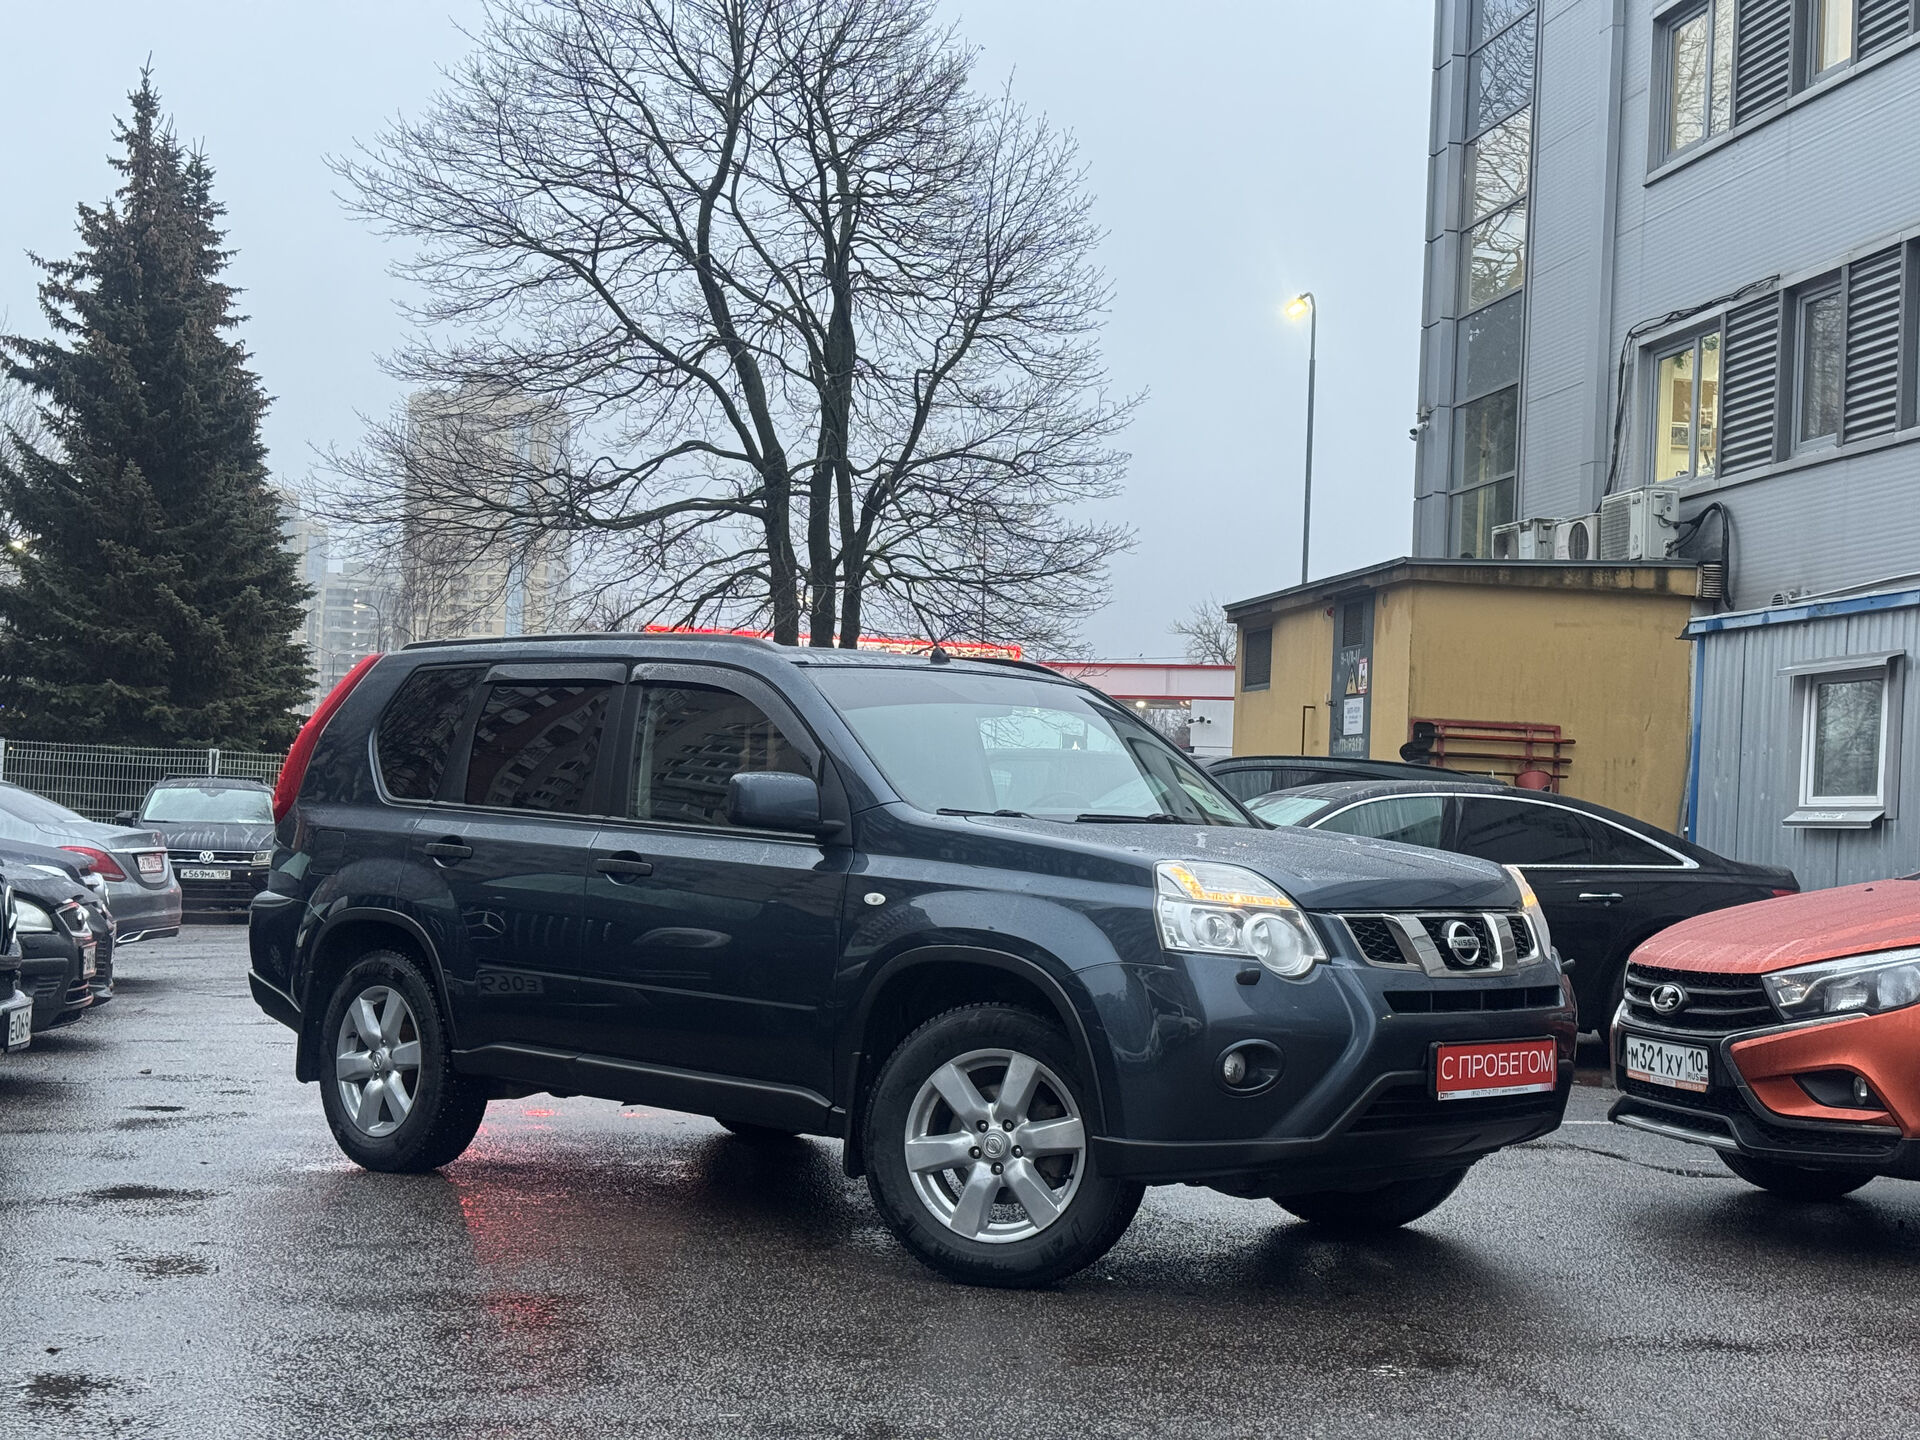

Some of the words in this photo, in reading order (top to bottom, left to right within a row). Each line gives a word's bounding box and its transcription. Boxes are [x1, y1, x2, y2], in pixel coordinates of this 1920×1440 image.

[1441, 1056, 1454, 1080] С
[1459, 1049, 1553, 1079] ПРОБЕГОМ
[1630, 1042, 1683, 1077] М321ХУ
[1688, 1050, 1703, 1073] 10
[1687, 1071, 1700, 1080] RUS
